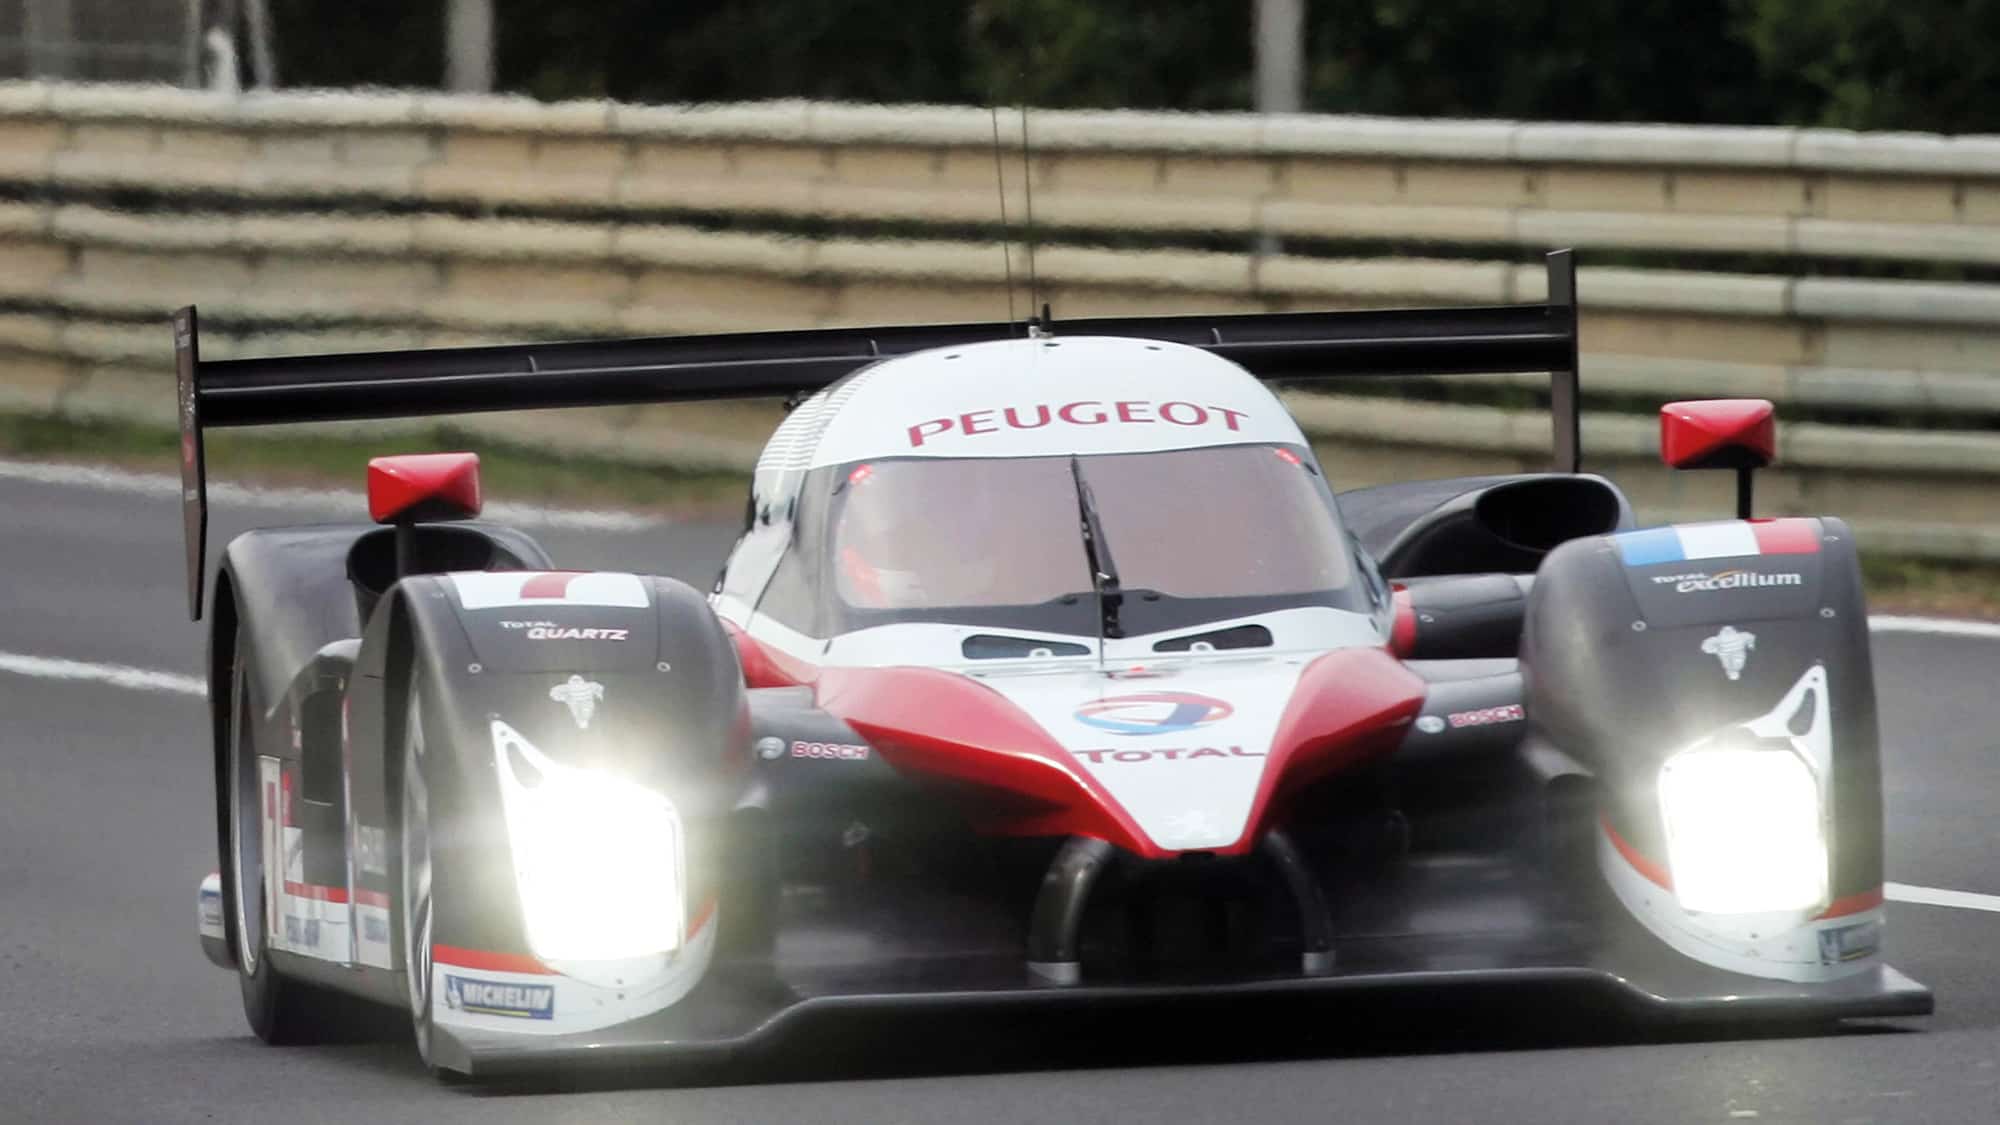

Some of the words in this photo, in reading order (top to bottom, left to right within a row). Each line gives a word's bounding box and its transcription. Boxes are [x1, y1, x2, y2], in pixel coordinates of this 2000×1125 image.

[907, 400, 1249, 447] PEUGEOT
[1675, 571, 1802, 593] excellium
[527, 627, 629, 640] QUARTZ
[1448, 704, 1525, 729] BOSCH
[791, 741, 870, 760] BOSCH
[1070, 746, 1267, 764] TOTAL
[462, 983, 551, 1011] MICHELIN
